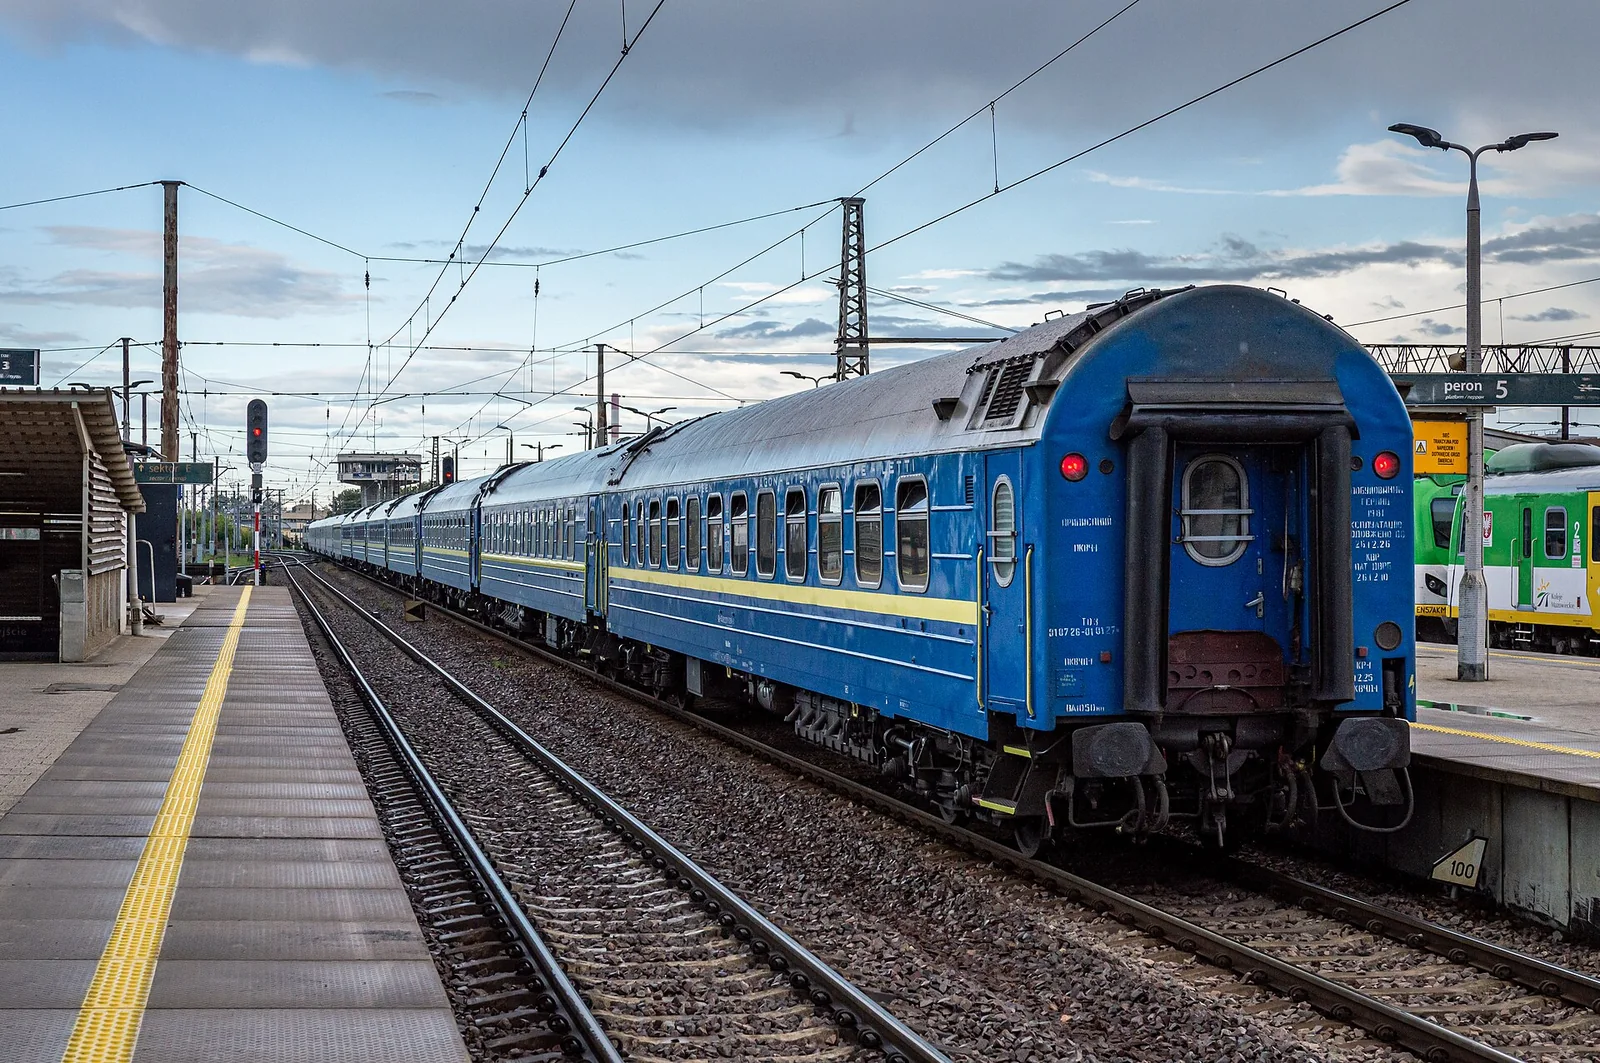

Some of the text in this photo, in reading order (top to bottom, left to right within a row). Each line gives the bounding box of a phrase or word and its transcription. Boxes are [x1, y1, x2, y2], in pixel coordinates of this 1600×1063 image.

[2, 361, 10, 370] 3
[1444, 380, 1508, 399] peron 5
[1351, 521, 1403, 529] КСПЛУАТАЦІЮ
[1574, 521, 1580, 538] 2
[0, 627, 27, 637] jście
[1451, 860, 1475, 879] 100
